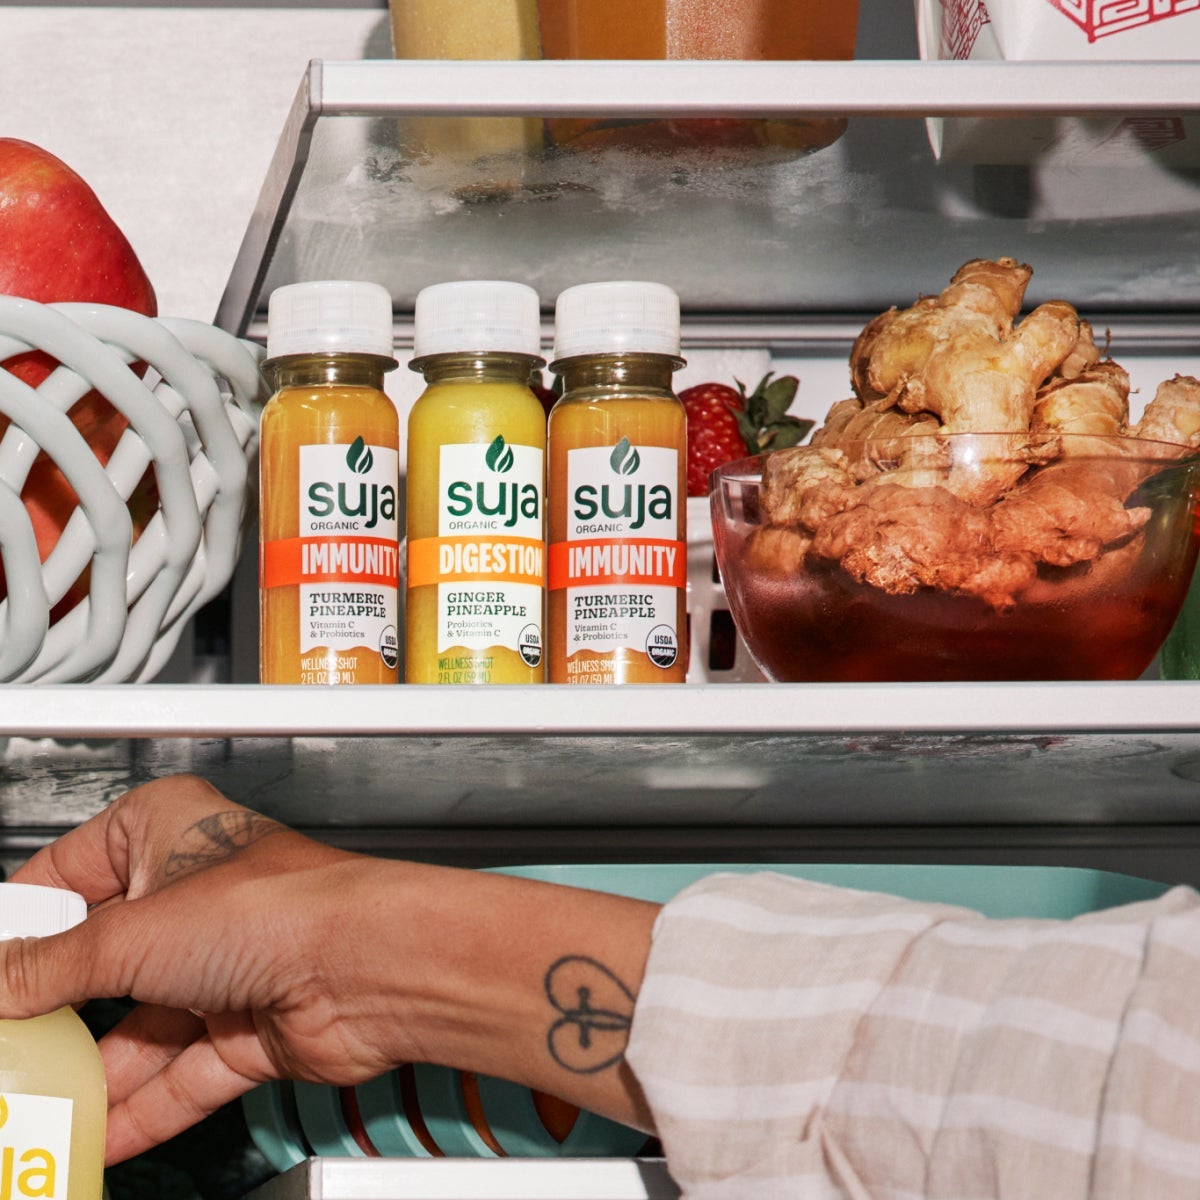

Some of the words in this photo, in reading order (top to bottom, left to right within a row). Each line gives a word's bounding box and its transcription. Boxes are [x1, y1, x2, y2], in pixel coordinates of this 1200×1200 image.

[308, 482, 395, 528] suja
[447, 481, 539, 527] suja
[574, 484, 672, 530] suja
[310, 521, 360, 531] ORGANIC
[449, 520, 498, 530] ORGANIC
[576, 524, 623, 534] ORGANIC
[302, 542, 398, 578] IMMUNITY
[439, 543, 542, 578] DIGESTION
[568, 544, 677, 579] IMMUNITY
[310, 592, 384, 605] TURMERIC
[447, 592, 505, 604] GINGER
[574, 594, 654, 607] TURMERIC
[310, 606, 386, 618] PINEAPPLE
[447, 604, 527, 617] PINEAPPLE
[574, 607, 656, 620] PINEAPPLE
[310, 621, 346, 629] Vitamin
[447, 620, 493, 628] Probiotics
[574, 623, 608, 632] Vitamin
[582, 632, 628, 640] Probiotics
[654, 635, 672, 645] USDA
